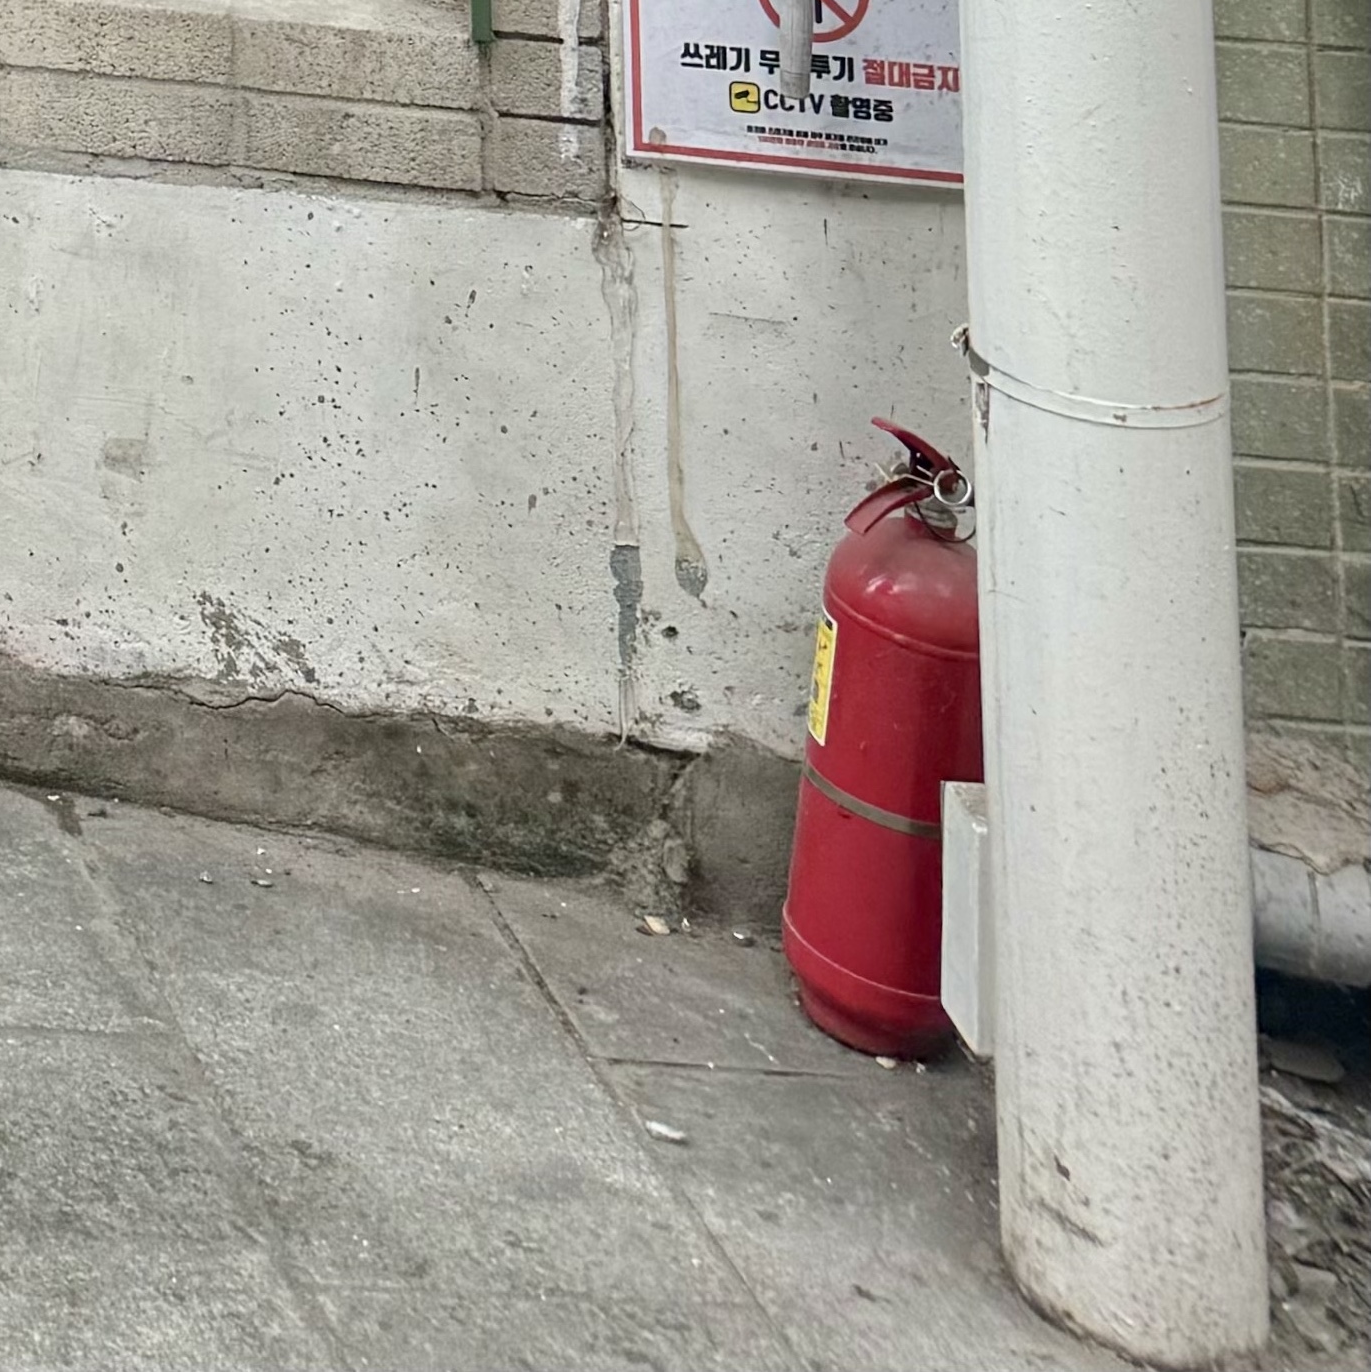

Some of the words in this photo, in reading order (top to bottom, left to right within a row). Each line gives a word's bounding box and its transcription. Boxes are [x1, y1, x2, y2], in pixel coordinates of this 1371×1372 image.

[680, 42, 750, 73] 쓰레기
[862, 58, 960, 93] 절대금지
[830, 94, 894, 123] 촬영중
